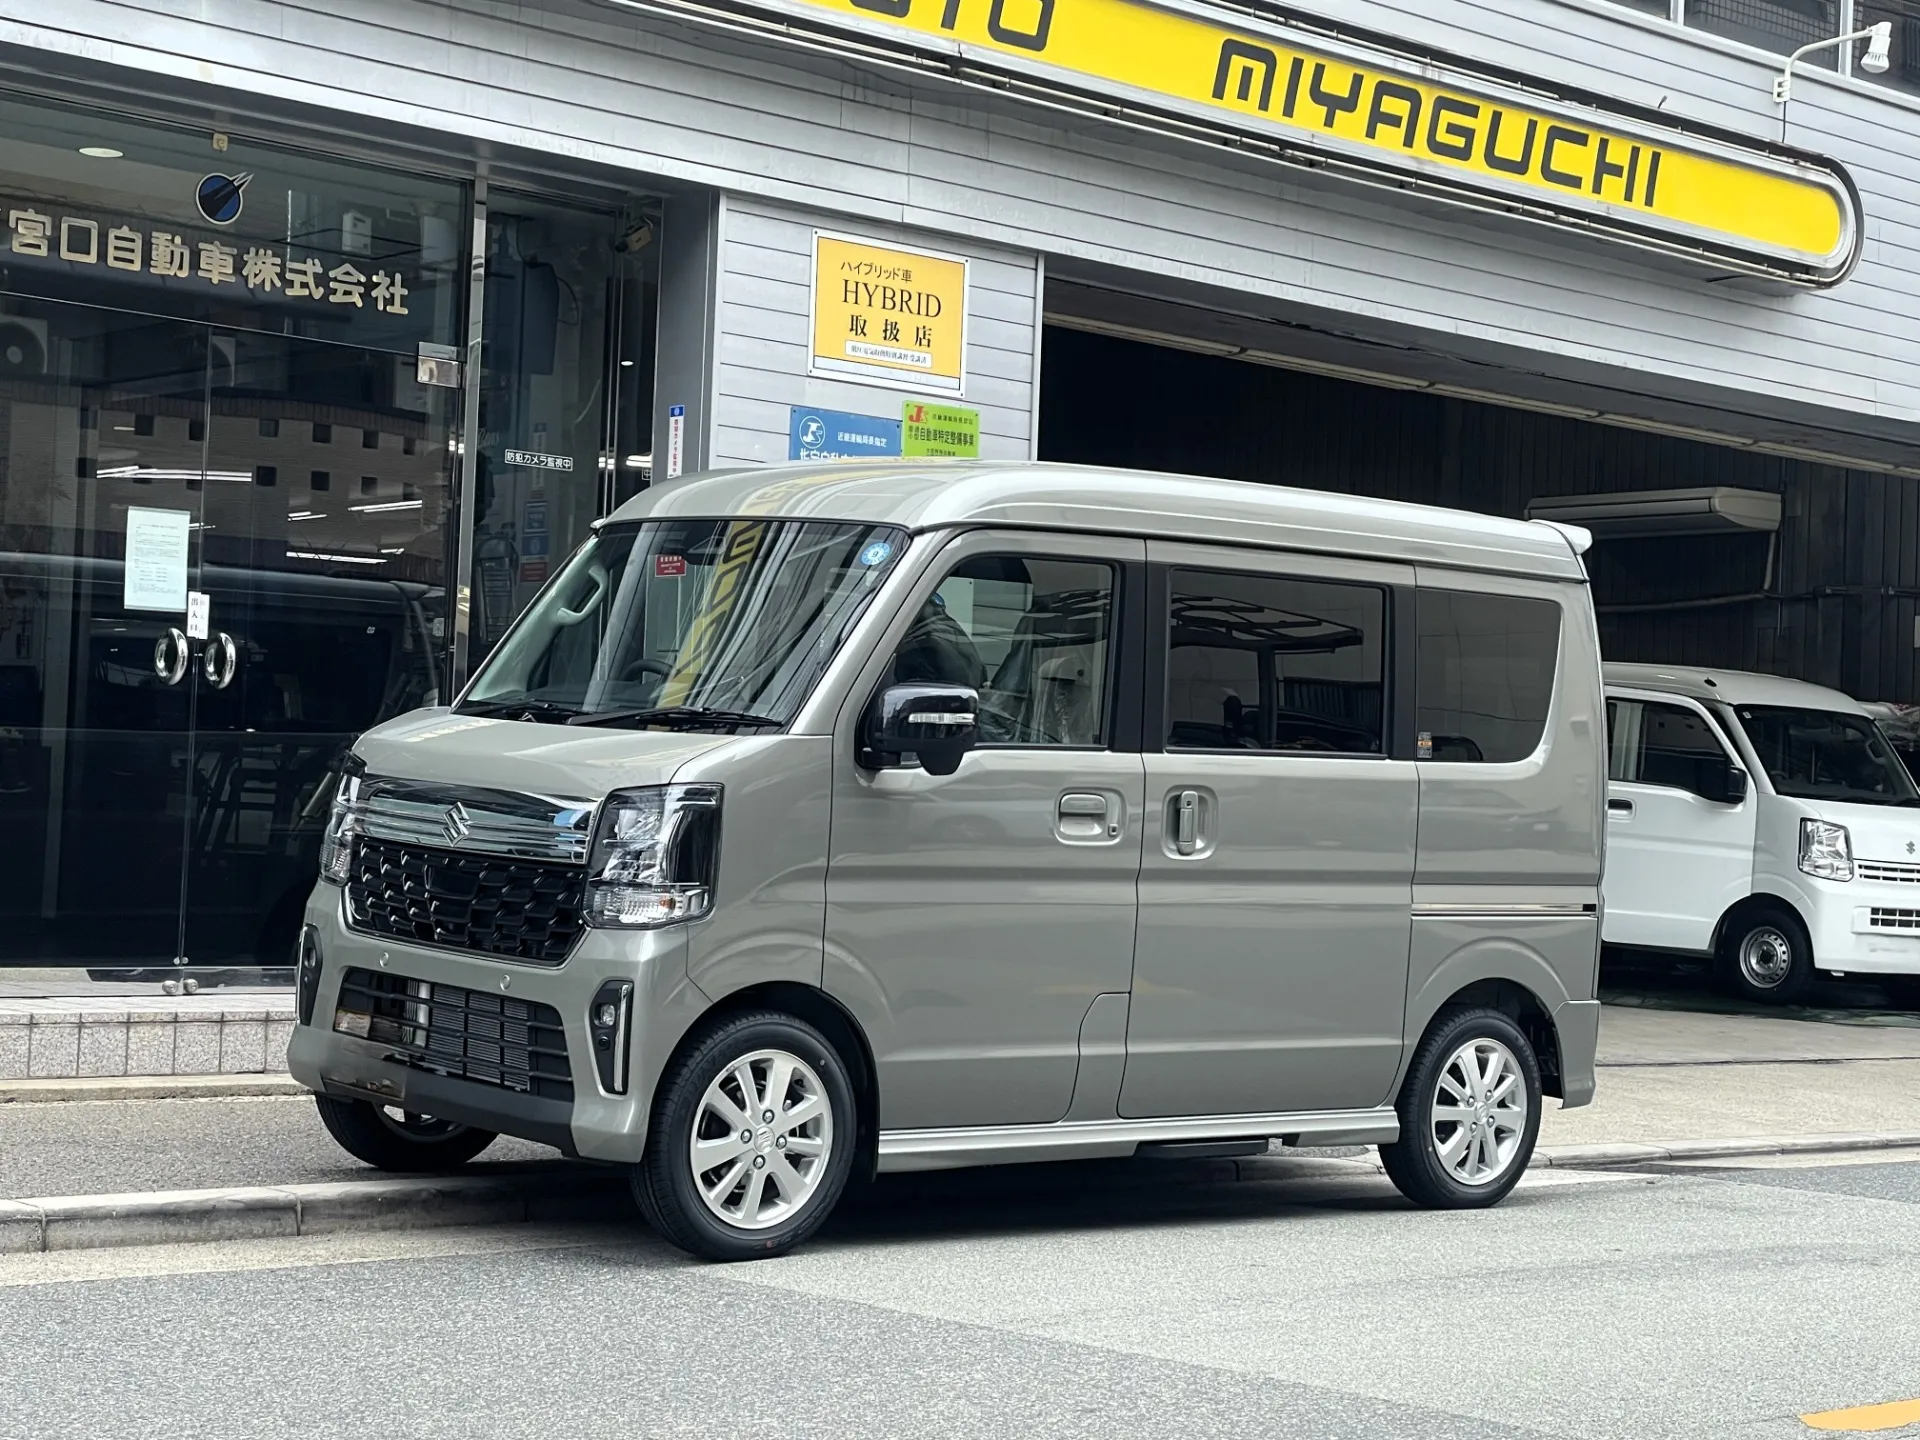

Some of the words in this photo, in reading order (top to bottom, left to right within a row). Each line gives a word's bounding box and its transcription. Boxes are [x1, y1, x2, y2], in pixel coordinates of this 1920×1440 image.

[1212, 38, 1661, 208] MIYAGUCHI
[9, 208, 409, 314] 宮口自動車株式会社
[840, 261, 912, 283] ハイブリッド車
[842, 278, 942, 318] HYBRID
[849, 314, 932, 348] 取扱店
[507, 451, 571, 469] 防犯カメラ監視中
